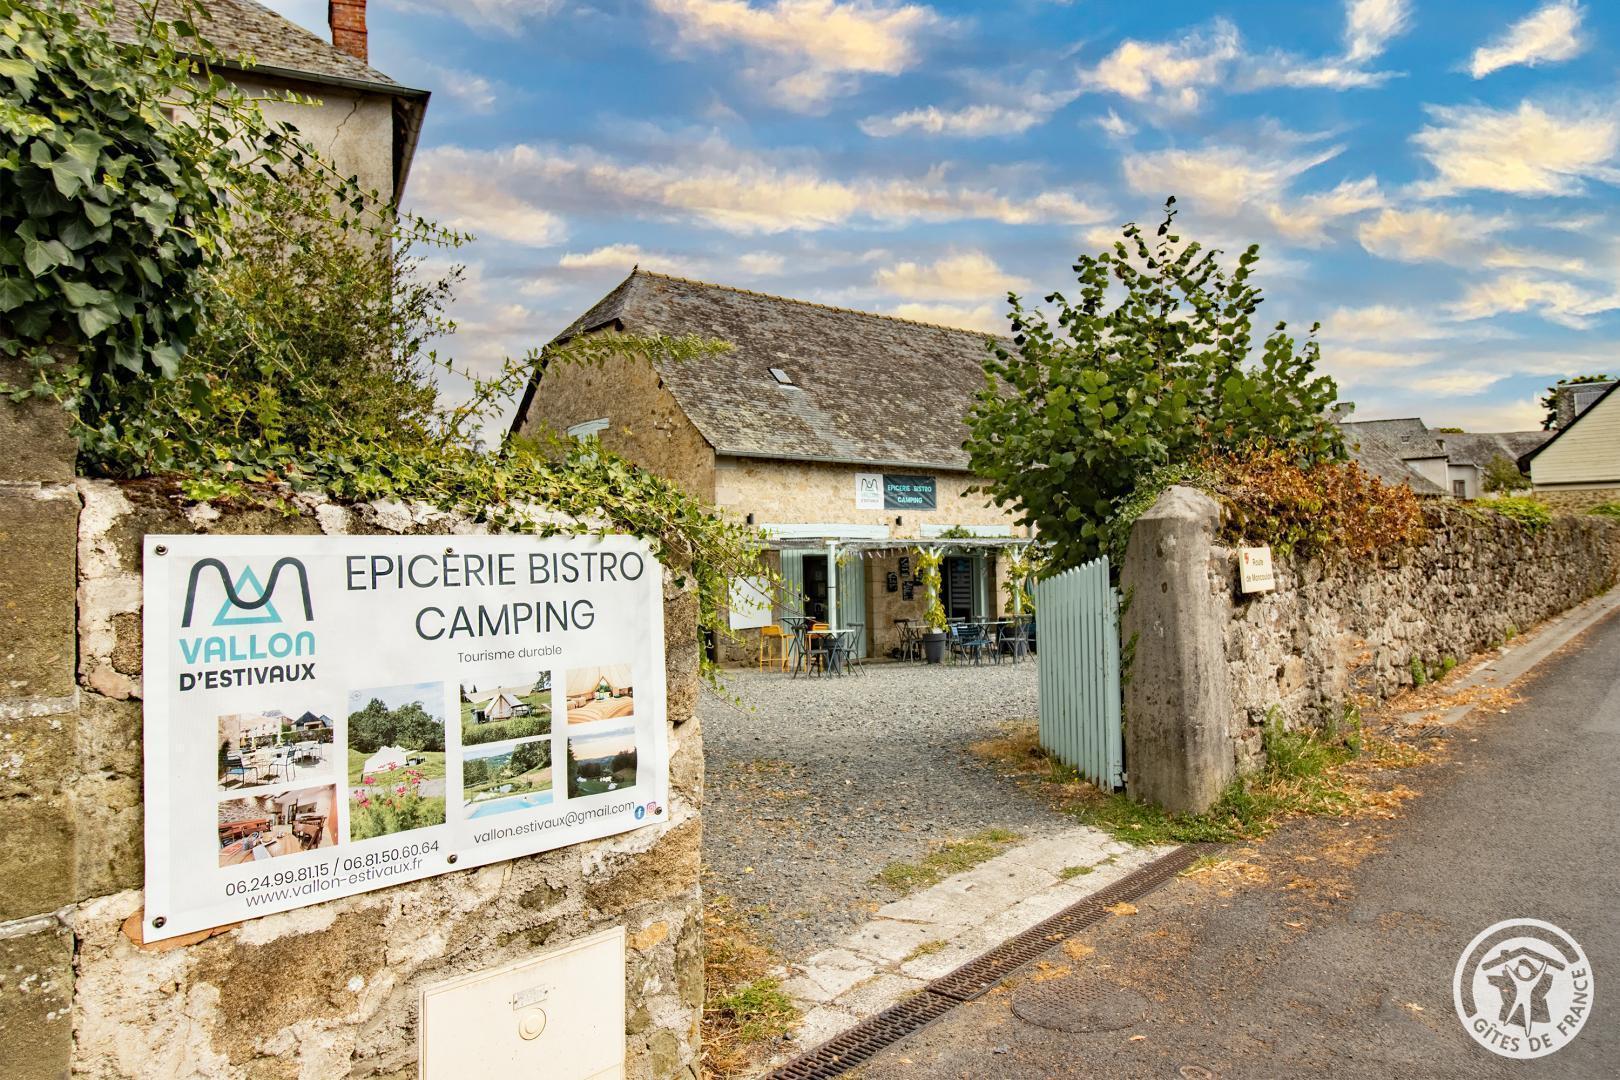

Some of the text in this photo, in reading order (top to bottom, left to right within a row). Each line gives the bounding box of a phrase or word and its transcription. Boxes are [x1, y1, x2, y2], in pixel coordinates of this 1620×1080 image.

[346, 551, 645, 591] EPICERIE BISTRO
[415, 599, 595, 641] CAMPING
[179, 631, 316, 665] VALLON
[458, 645, 563, 663] Tourisme durable
[473, 801, 635, 844] vallon.estivaux@gmail.com
[225, 862, 330, 897] 06.24.99.81.15
[343, 840, 440, 871] 06.81.50.60.64
[245, 857, 424, 908] www.vallon-estivaux.fr
